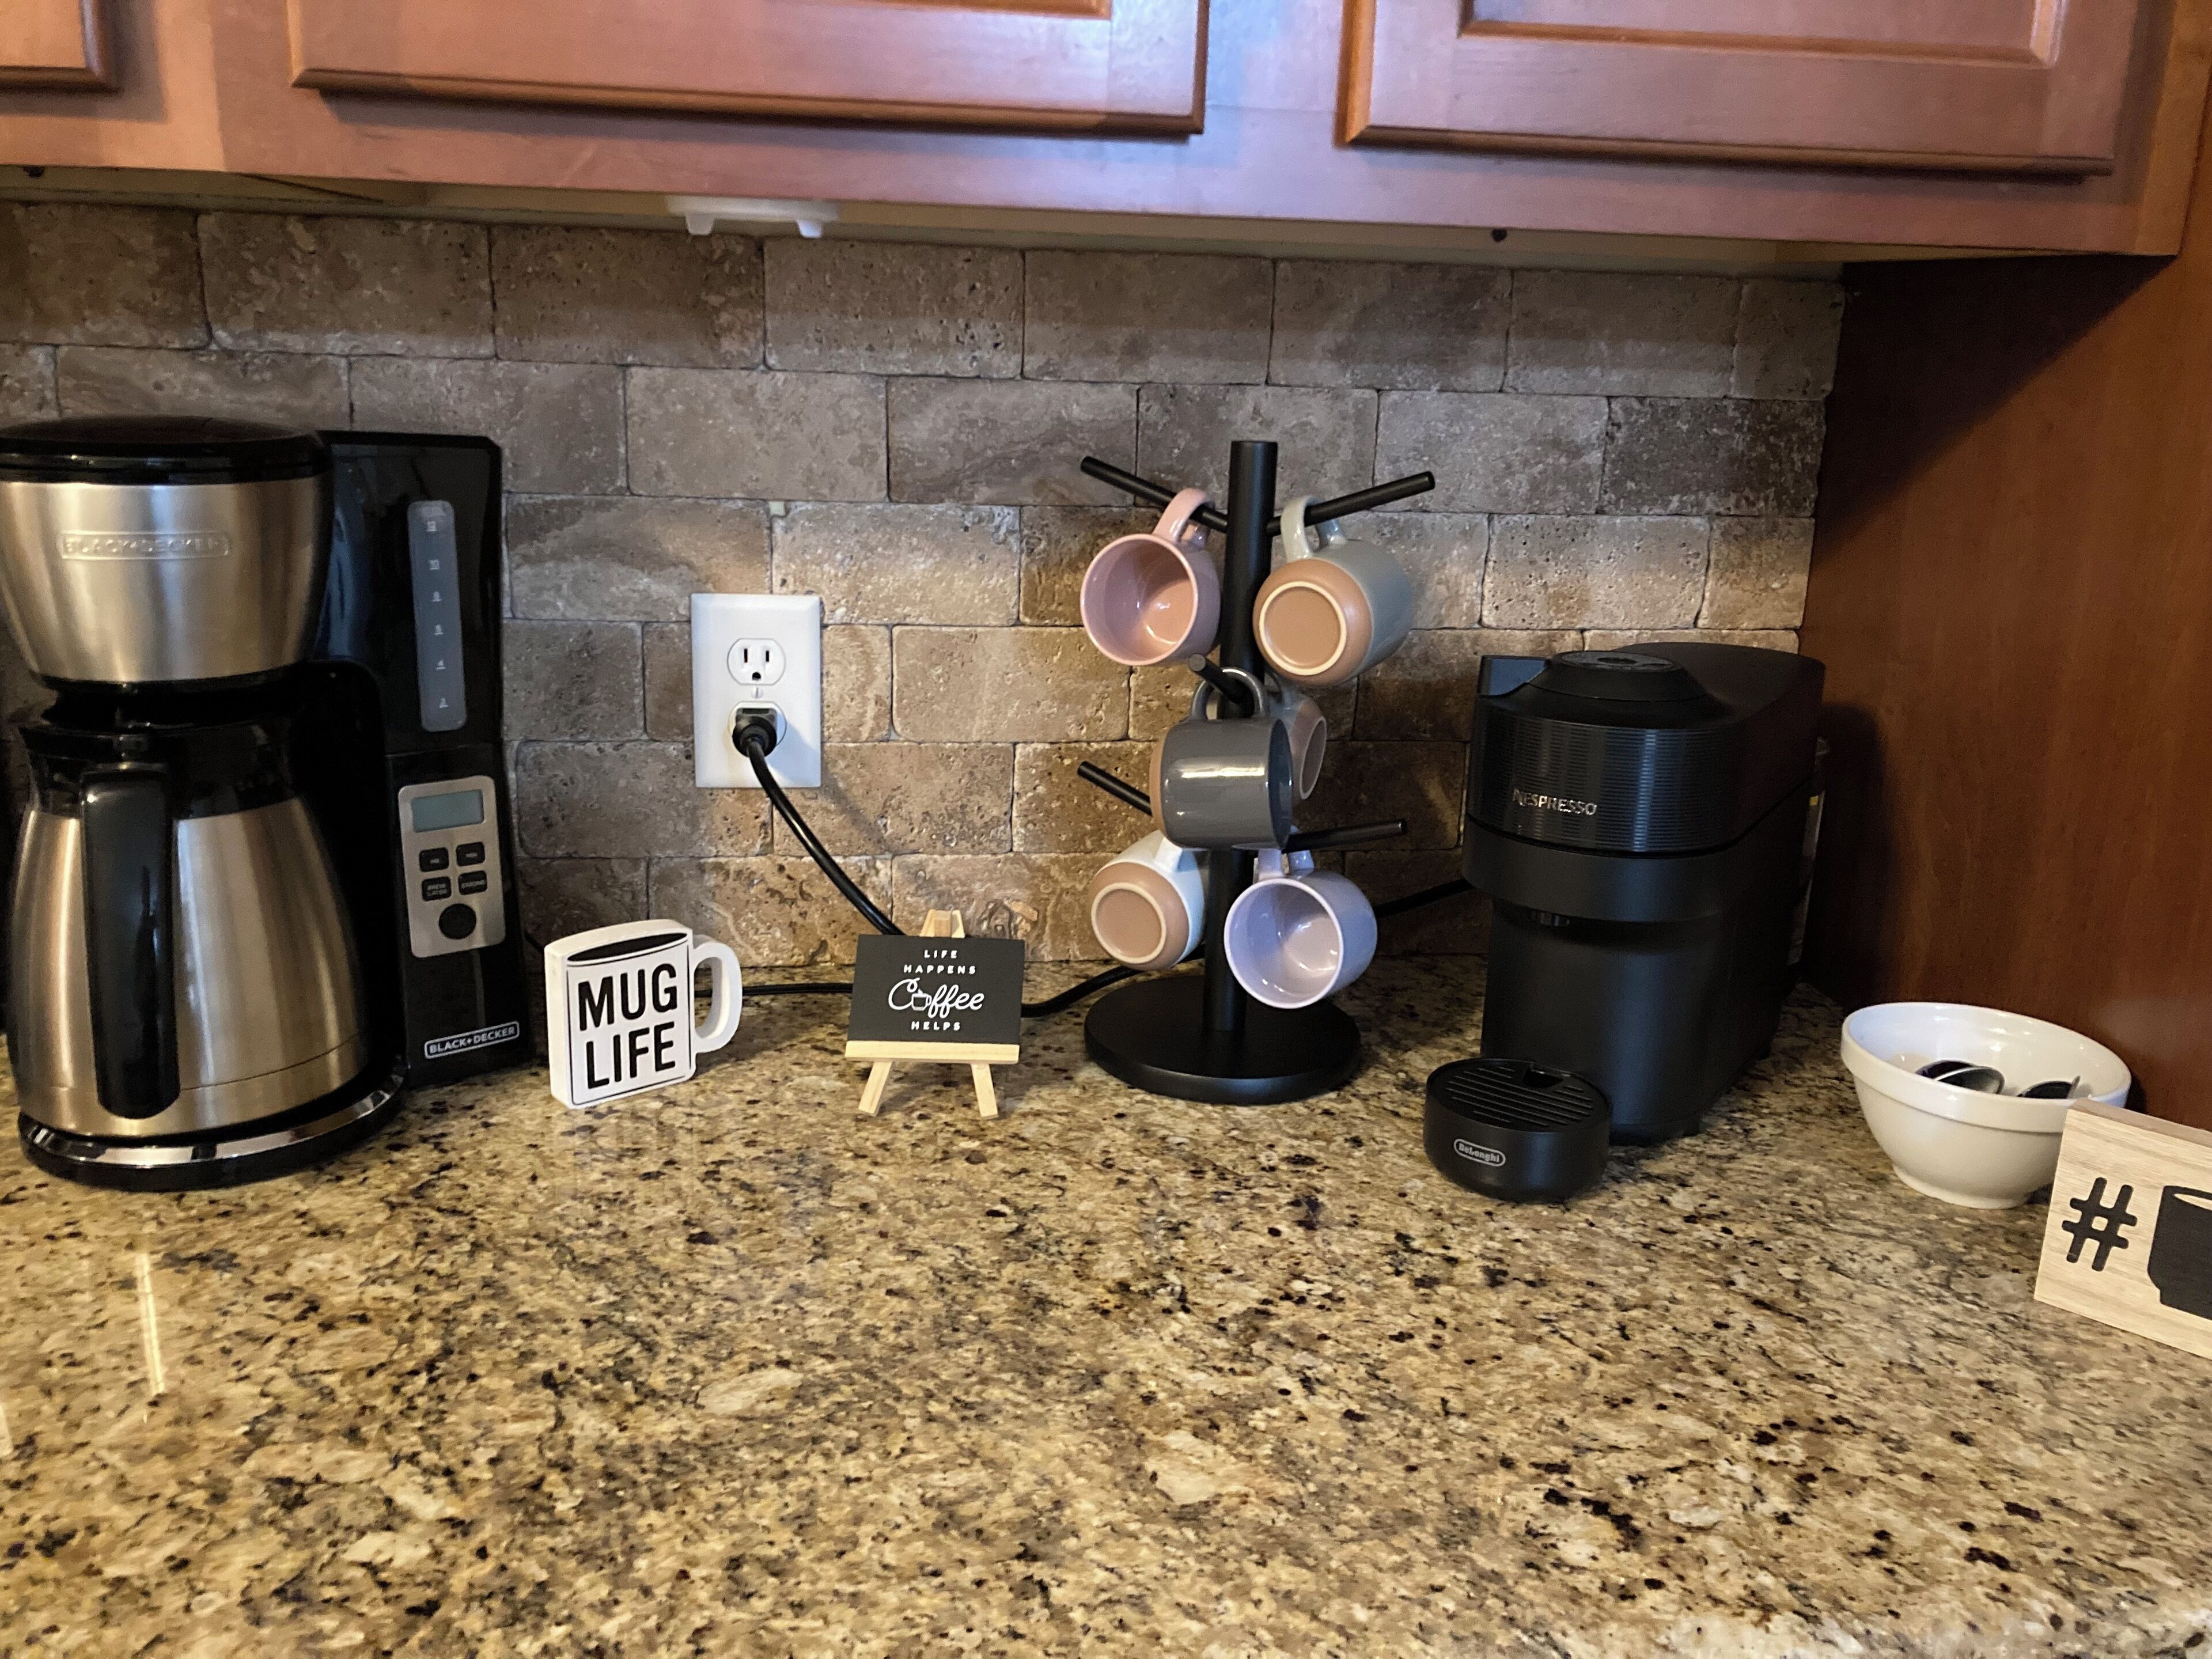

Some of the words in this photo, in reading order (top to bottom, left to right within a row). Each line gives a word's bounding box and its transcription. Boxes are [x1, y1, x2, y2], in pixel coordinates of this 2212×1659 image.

[1512, 787, 1597, 816] NESPRESSO
[923, 949, 957, 959] LIFE
[903, 964, 976, 975] HAPPENS
[578, 963, 677, 1031] MUG
[888, 977, 984, 1018] Coffee
[429, 1026, 516, 1054] BLACK+DECKER
[911, 1021, 960, 1031] HELPS
[586, 1021, 676, 1089] LIFE
